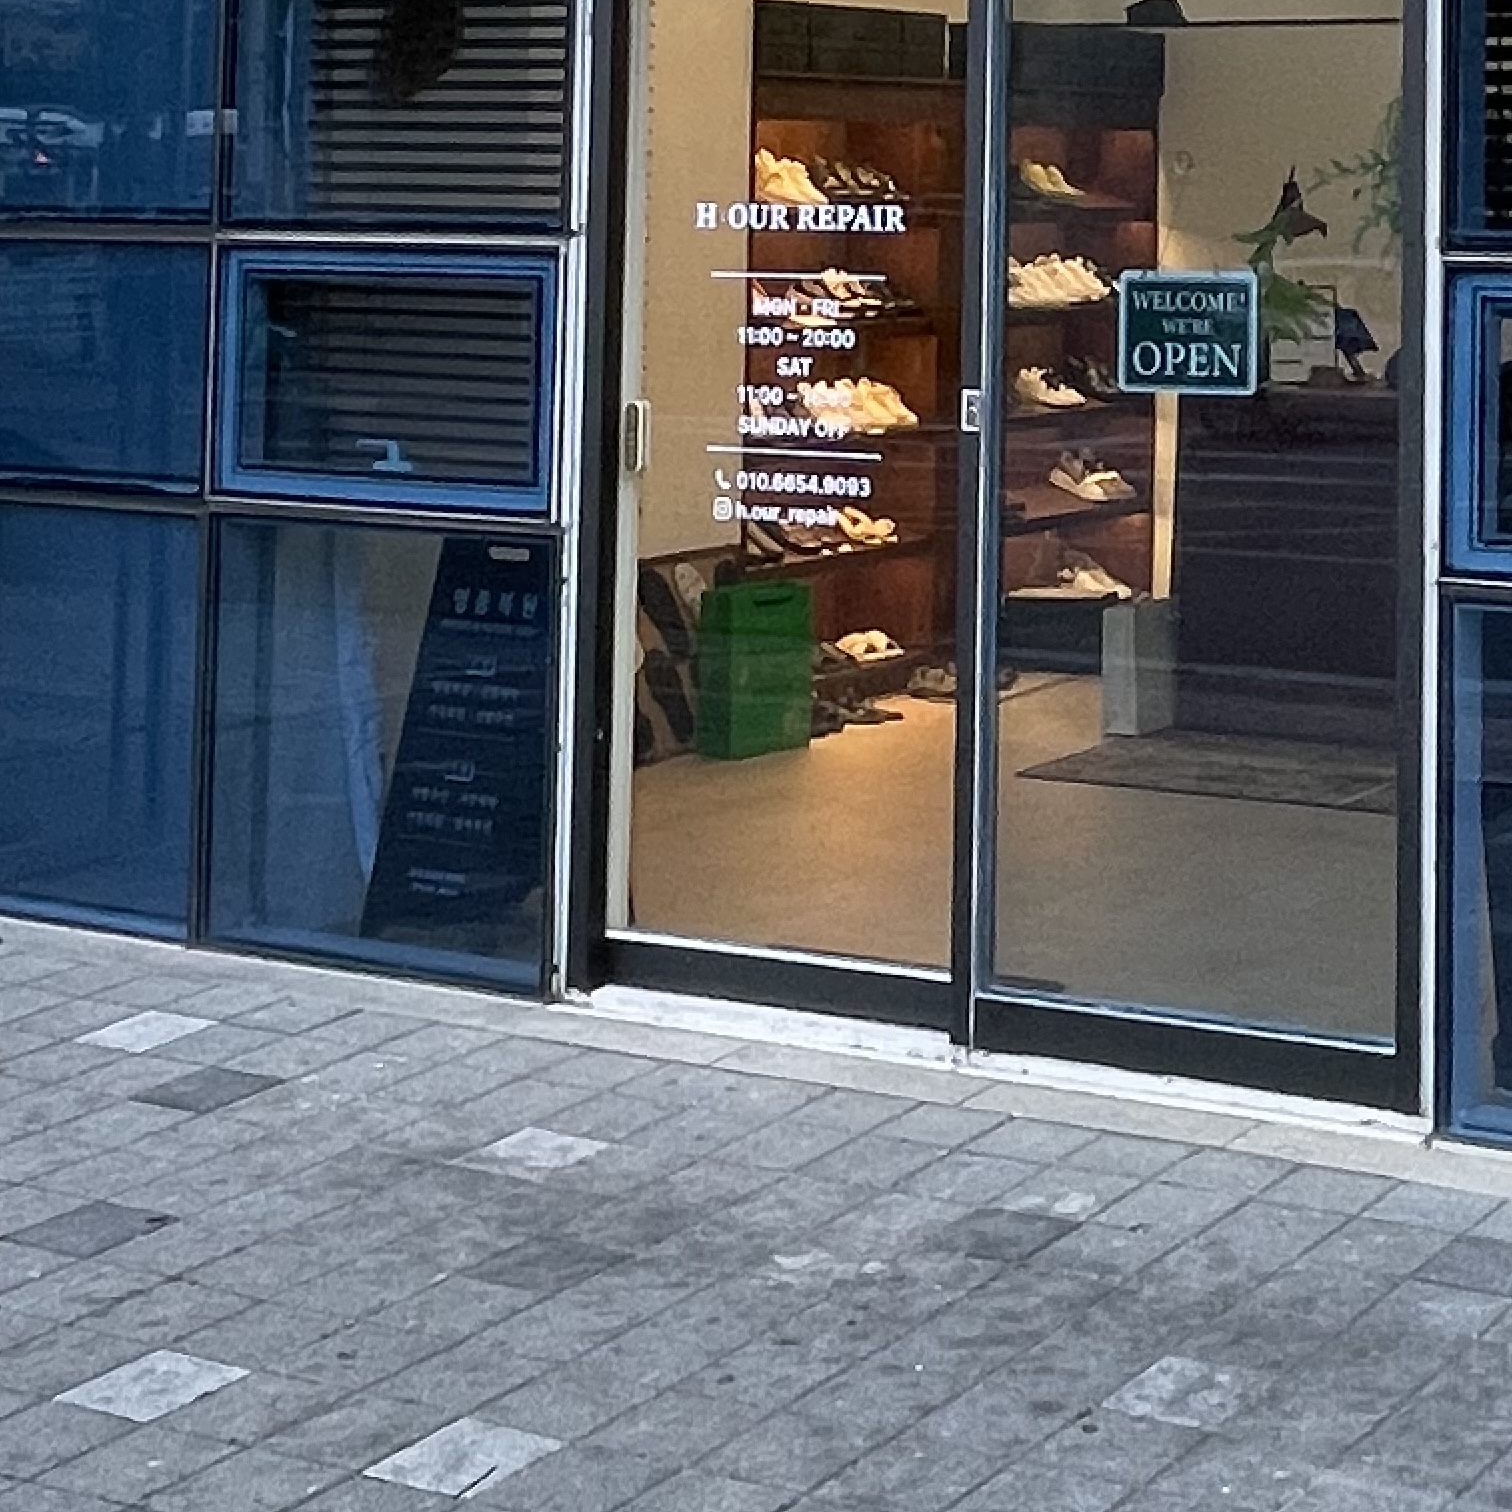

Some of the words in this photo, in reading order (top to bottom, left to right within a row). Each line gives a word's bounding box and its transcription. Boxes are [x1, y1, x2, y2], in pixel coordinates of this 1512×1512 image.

[797, 203, 907, 233] REPAIR
[736, 326, 784, 347] 11:00
[802, 328, 857, 349] 20:00
[776, 356, 814, 377] SAT
[1132, 340, 1243, 378] OPEN
[738, 415, 813, 438] SUNDAY
